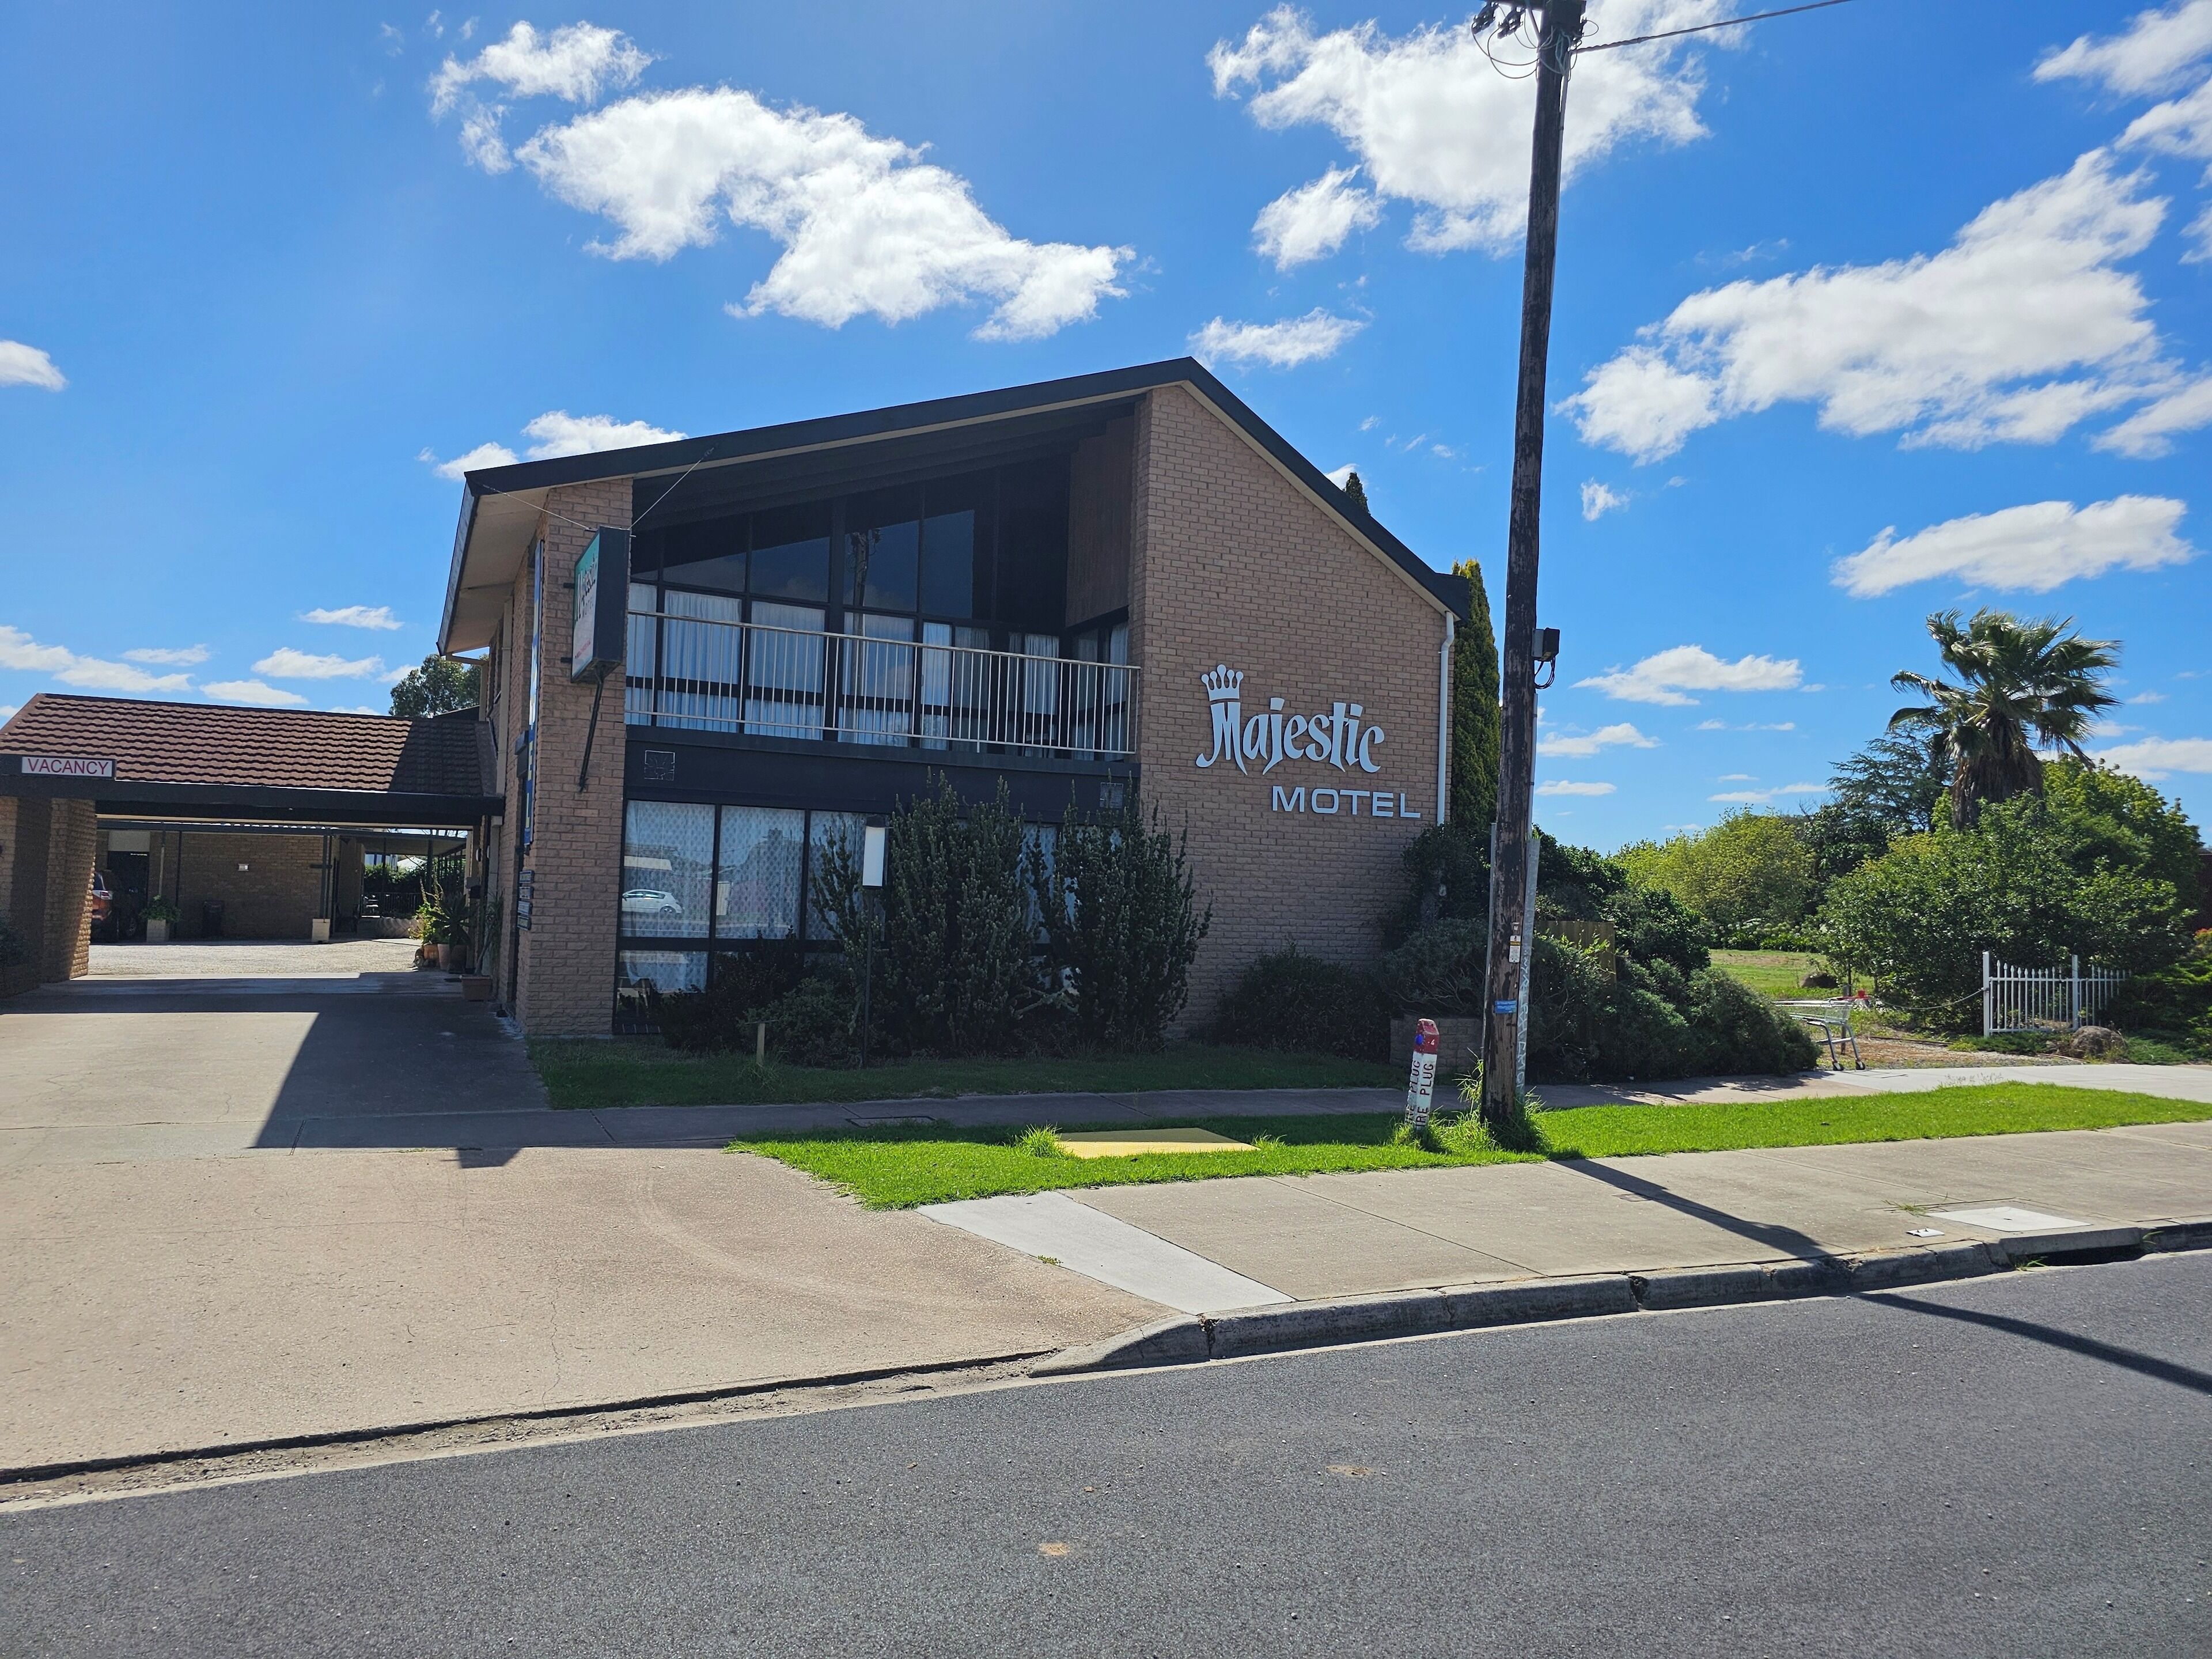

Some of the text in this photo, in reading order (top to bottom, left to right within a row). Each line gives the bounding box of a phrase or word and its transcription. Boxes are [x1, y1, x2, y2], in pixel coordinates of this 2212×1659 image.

[1195, 697, 1385, 775] Majestic
[28, 758, 109, 775] VACANCY
[1272, 785, 1421, 819] MOTEL
[1410, 1060, 1421, 1093] PLUG
[1415, 1063, 1434, 1127] IRE PLUG
